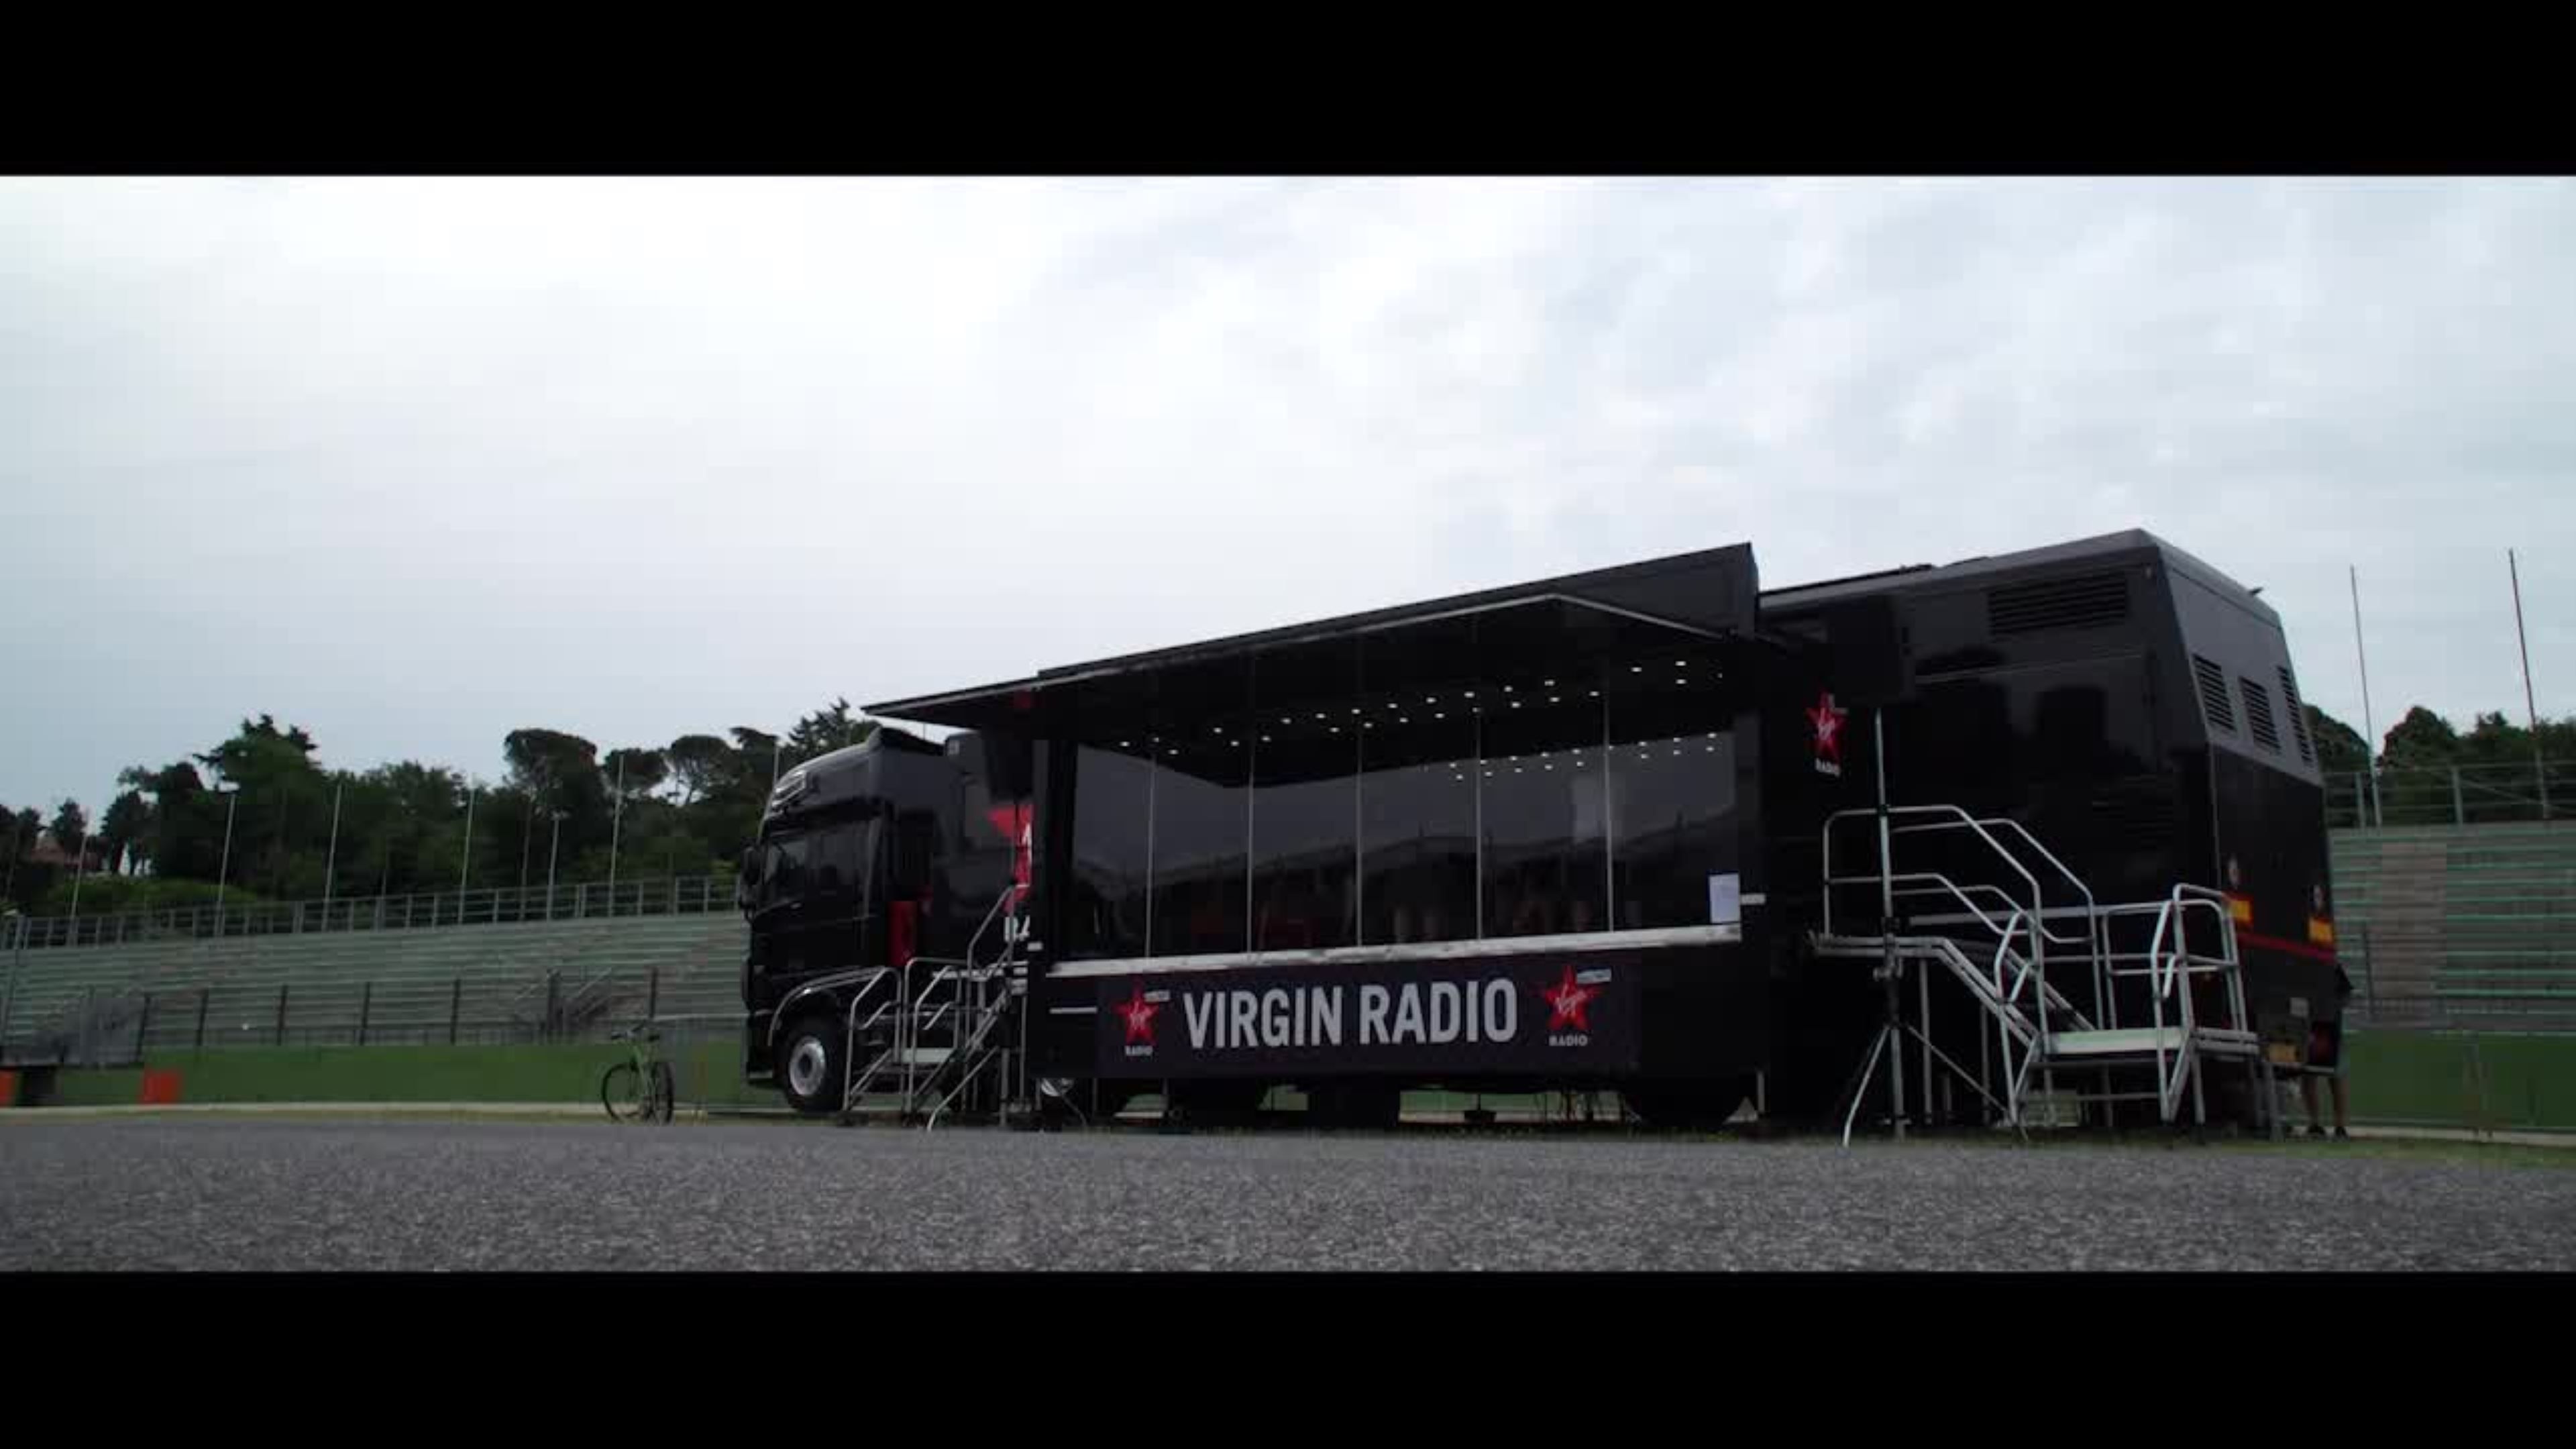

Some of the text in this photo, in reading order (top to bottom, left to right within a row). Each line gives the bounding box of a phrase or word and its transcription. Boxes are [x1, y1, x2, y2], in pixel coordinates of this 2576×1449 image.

[1183, 985, 1342, 1049] VIRGIN
[1359, 978, 1517, 1044] RADIO
[1548, 1034, 1589, 1046] RADIO
